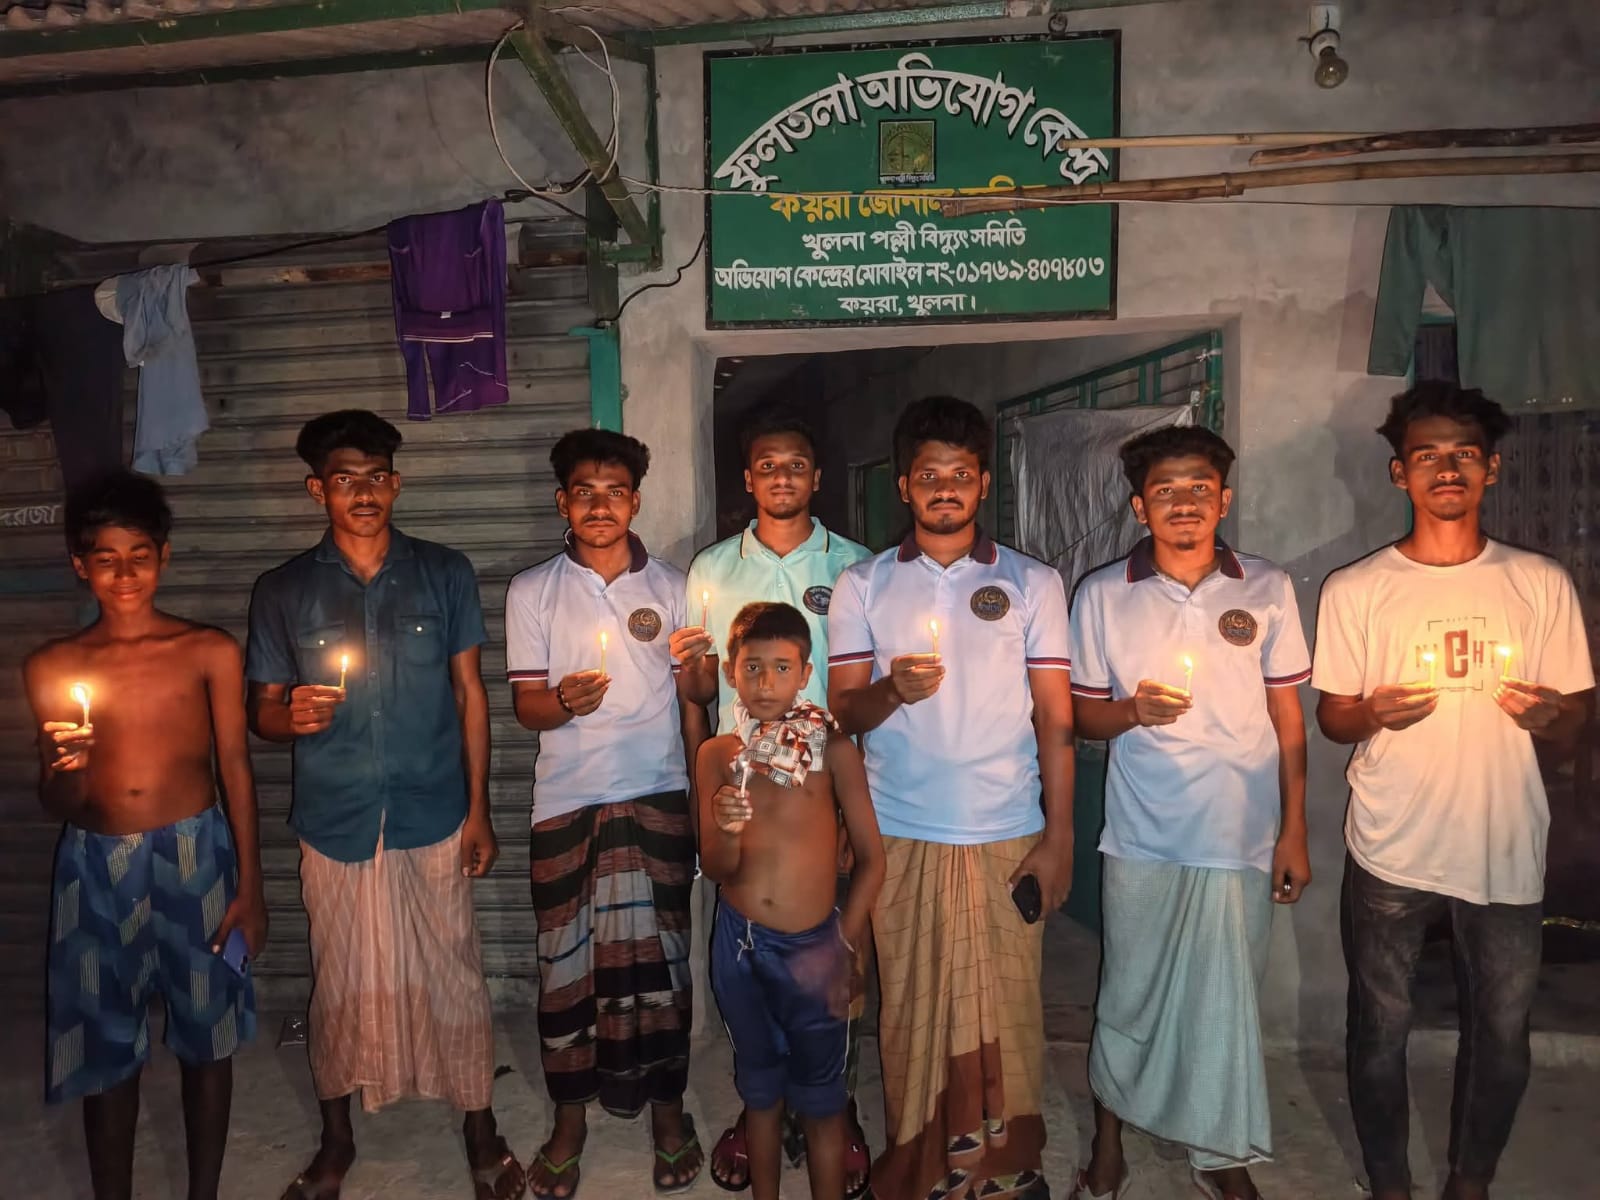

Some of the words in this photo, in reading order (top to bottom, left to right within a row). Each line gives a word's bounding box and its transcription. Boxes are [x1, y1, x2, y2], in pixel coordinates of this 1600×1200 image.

[713, 72, 858, 196] ফুলতলা
[854, 52, 1036, 136] অভিযোগ
[802, 231, 866, 261] খুলনা
[870, 220, 917, 254] পল্লী
[918, 222, 969, 256] বিদ্যুৎ
[969, 218, 1027, 248] সমিতি
[714, 258, 793, 290] অভিযোগ
[793, 264, 856, 289] কেন্দ্রের
[855, 255, 925, 289] মোবাইল
[837, 295, 903, 316] কয়রা,
